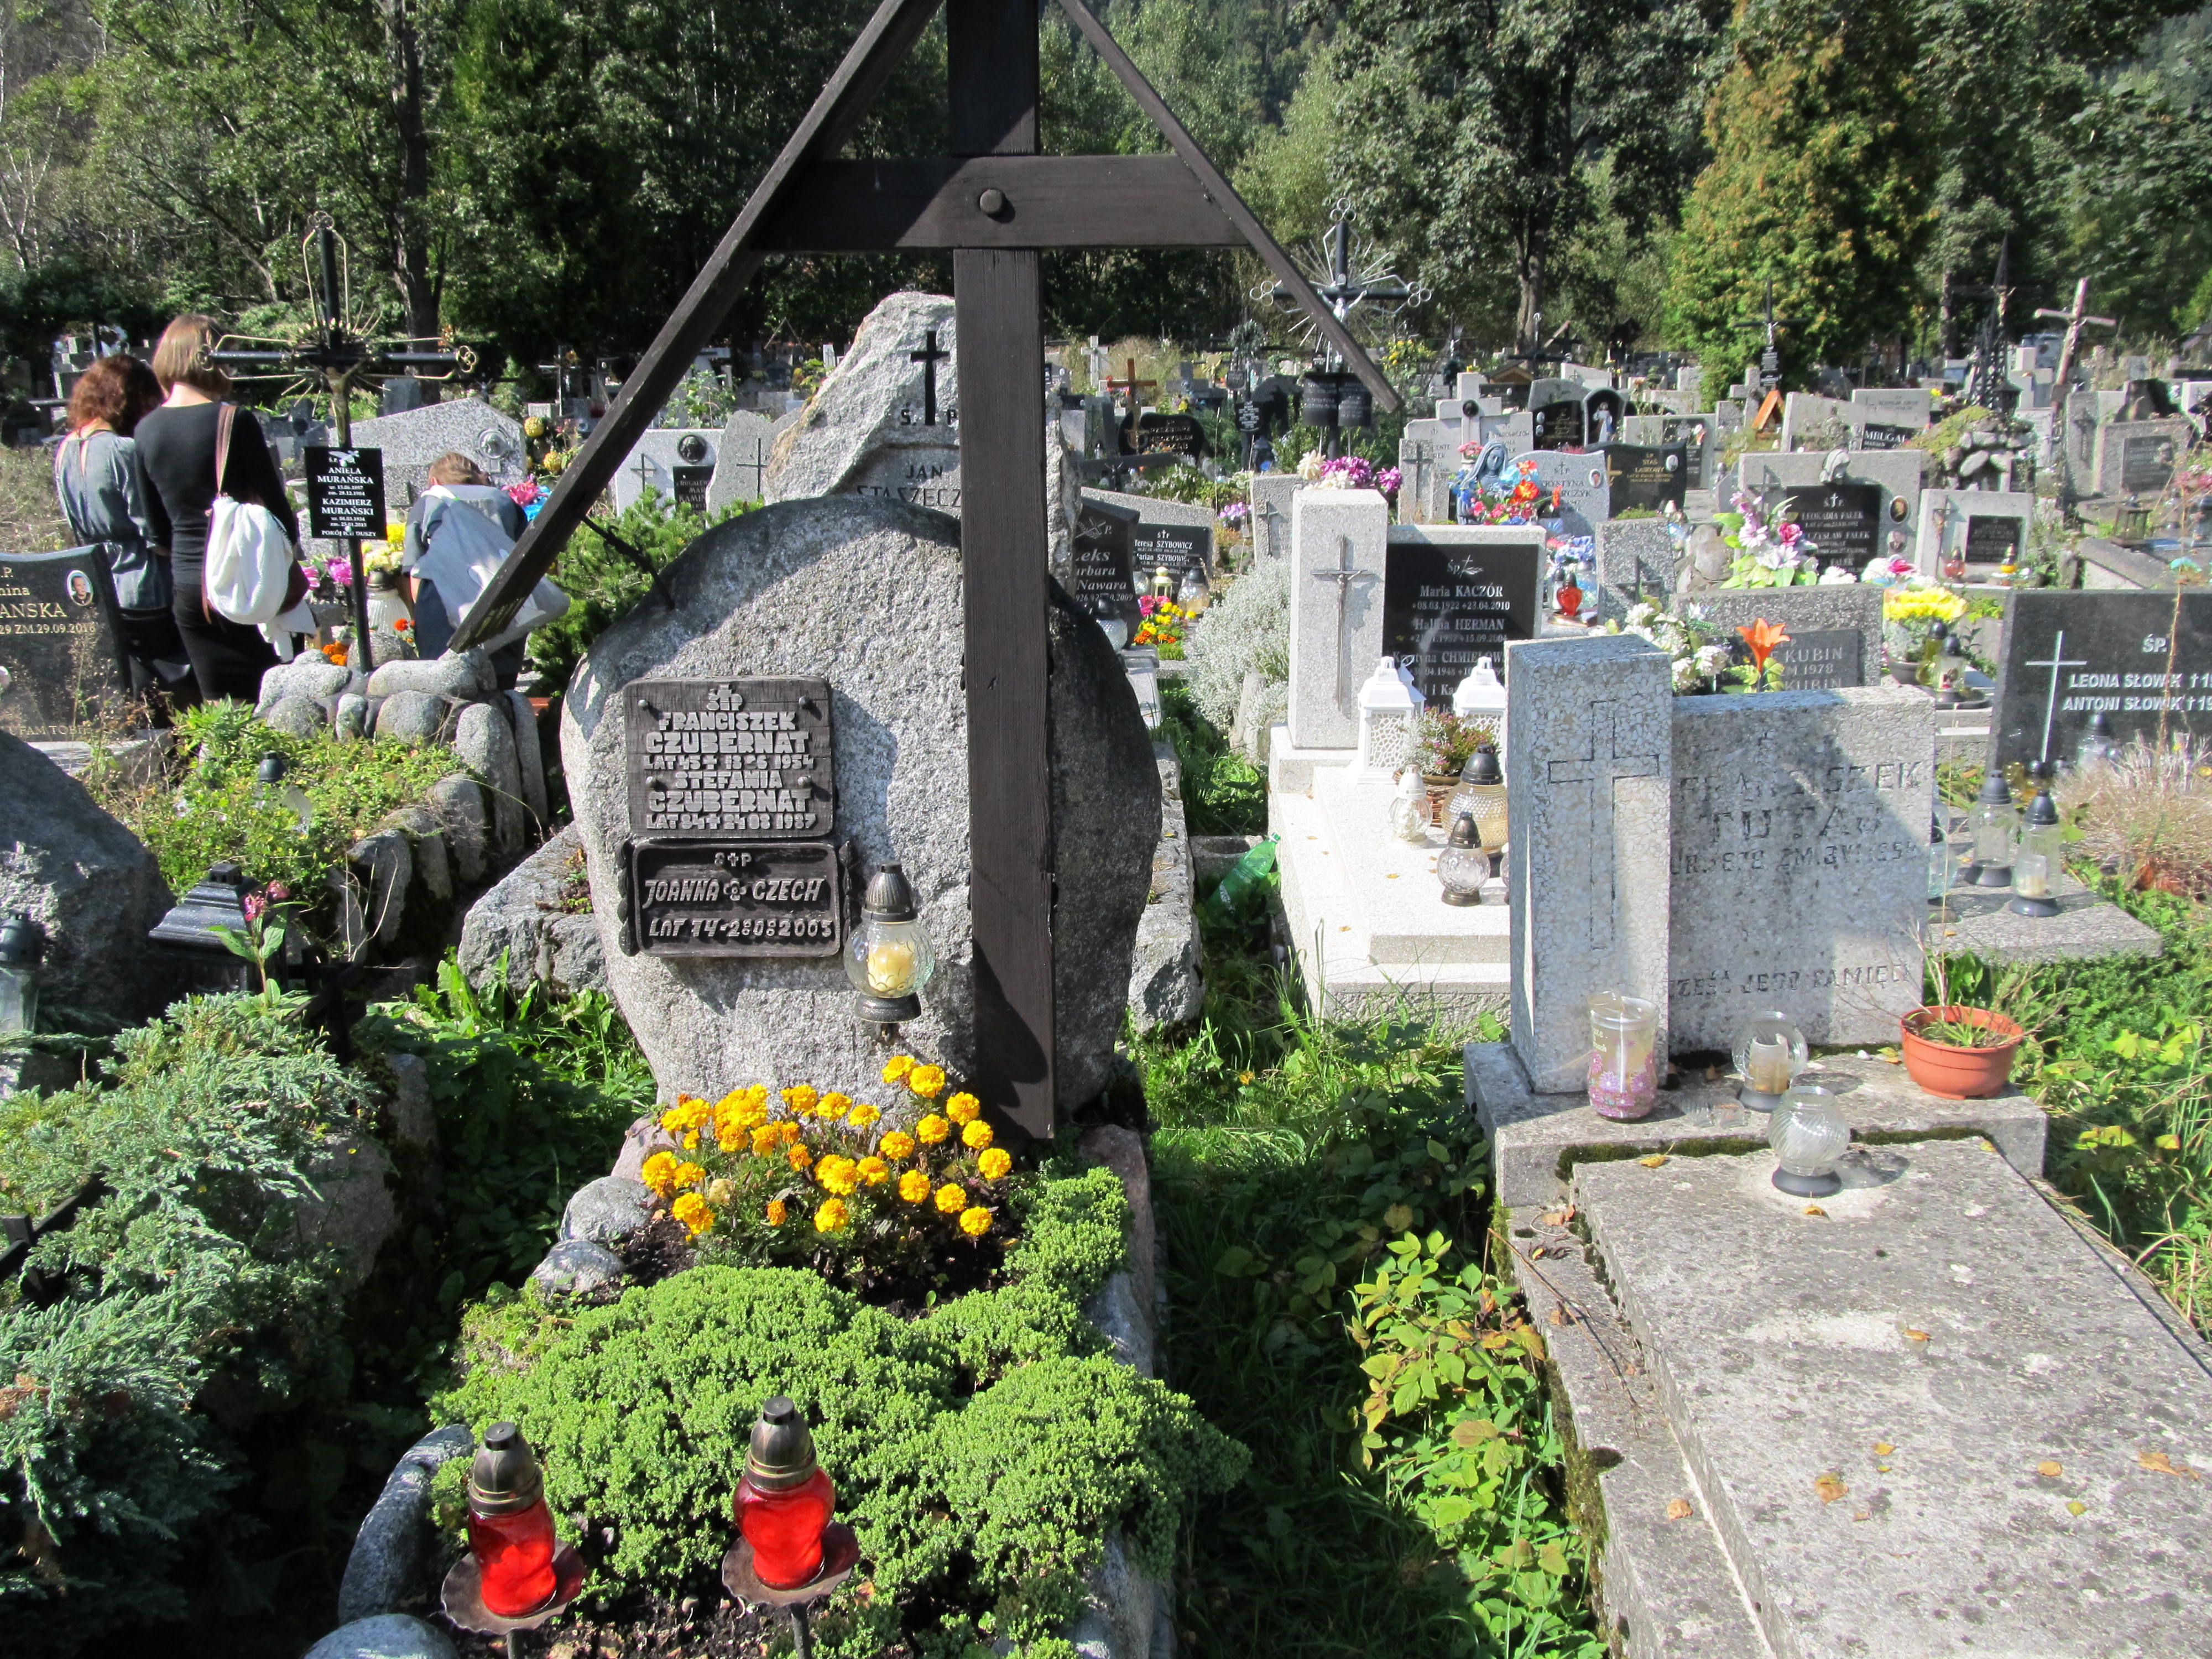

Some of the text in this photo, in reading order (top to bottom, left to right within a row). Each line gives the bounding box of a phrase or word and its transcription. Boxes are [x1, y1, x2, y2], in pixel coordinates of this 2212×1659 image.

[317, 474, 374, 484] MURAŃSKA
[906, 465, 943, 479] JAN
[322, 498, 372, 506] KAZIMIERZ
[321, 505, 374, 515] MURAŃSKI
[1156, 540, 1193, 550] SZYBOWICZ
[1076, 548, 1110, 562] eks
[1077, 579, 1128, 591] Nawara
[1420, 582, 1504, 598] Maria KACZÓR
[1455, 618, 1505, 630] HERMAN
[2142, 633, 2168, 653] ŚP.
[1785, 646, 1844, 663] KUBIN
[1804, 663, 1834, 675] 1978
[2069, 673, 2120, 687] LEONA
[2062, 696, 2121, 711] ANTONI
[659, 711, 796, 731] FRANCISZEK
[646, 731, 812, 754] CZUBERNAT
[643, 754, 676, 770] LAT
[679, 754, 701, 770] 45
[774, 754, 815, 770] 1954
[675, 770, 783, 790] STEFANIA
[648, 789, 812, 813] CZUBERNAT
[646, 813, 679, 830] LAT
[723, 813, 746, 830] 24
[776, 813, 817, 830] 1987
[641, 878, 827, 909] JOANNA CZECH
